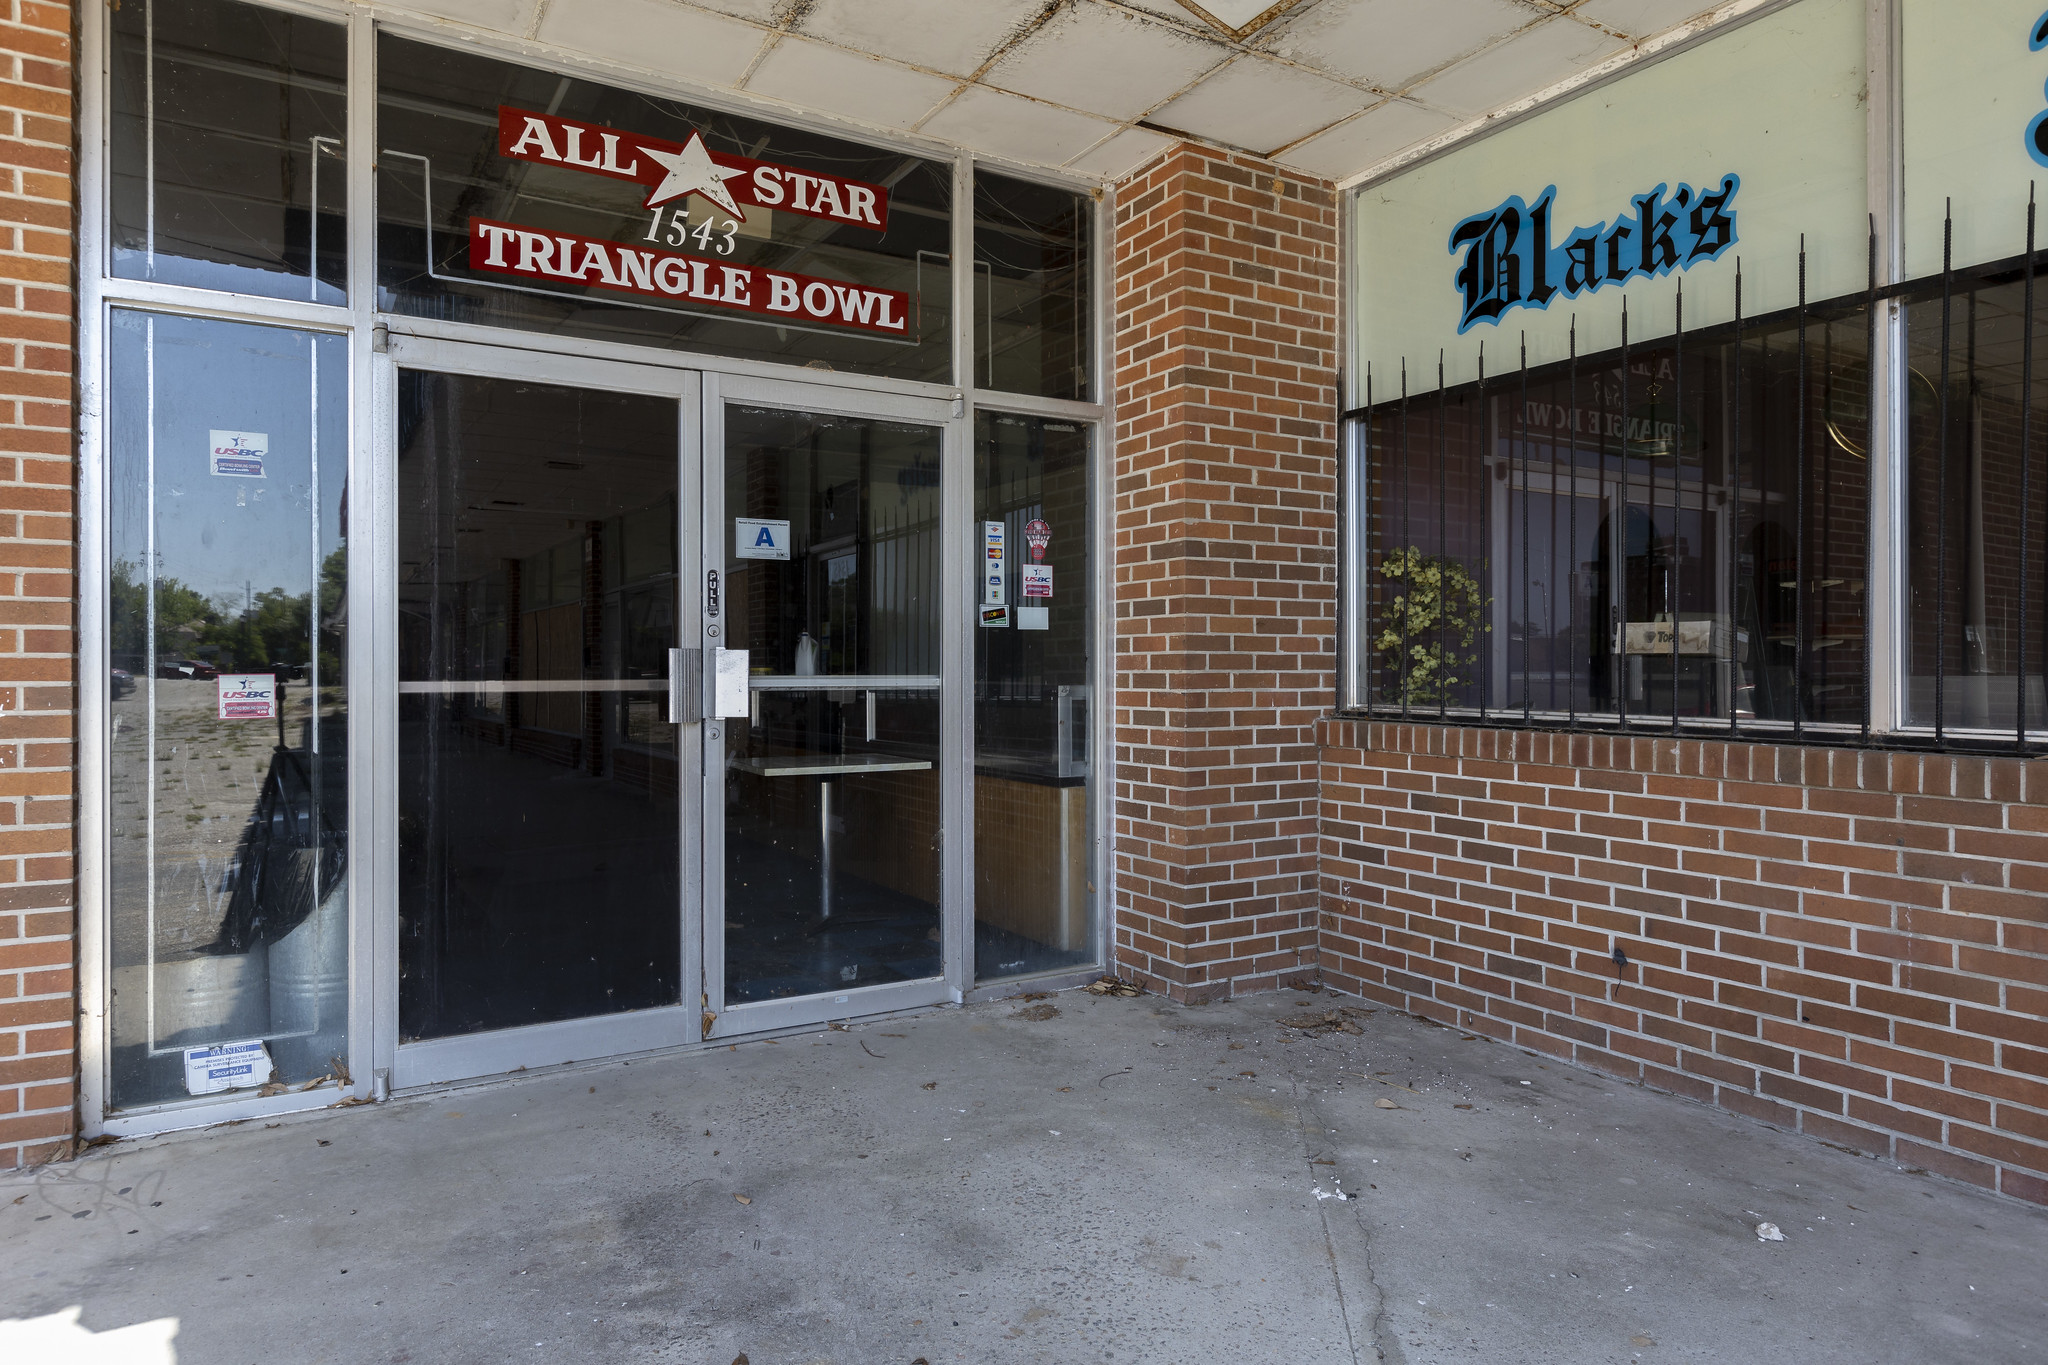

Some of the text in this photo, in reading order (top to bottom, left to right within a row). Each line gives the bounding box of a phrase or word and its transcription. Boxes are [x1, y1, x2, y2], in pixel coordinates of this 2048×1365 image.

[509, 115, 881, 226] ALL STAR
[642, 206, 739, 256] 1543
[1450, 175, 1738, 333] Black's
[478, 222, 904, 330] TRIANGLE BOWL
[215, 448, 263, 457] USBC
[754, 527, 775, 547] A
[709, 572, 717, 606] PULL
[212, 1066, 248, 1077] SecurityLink
